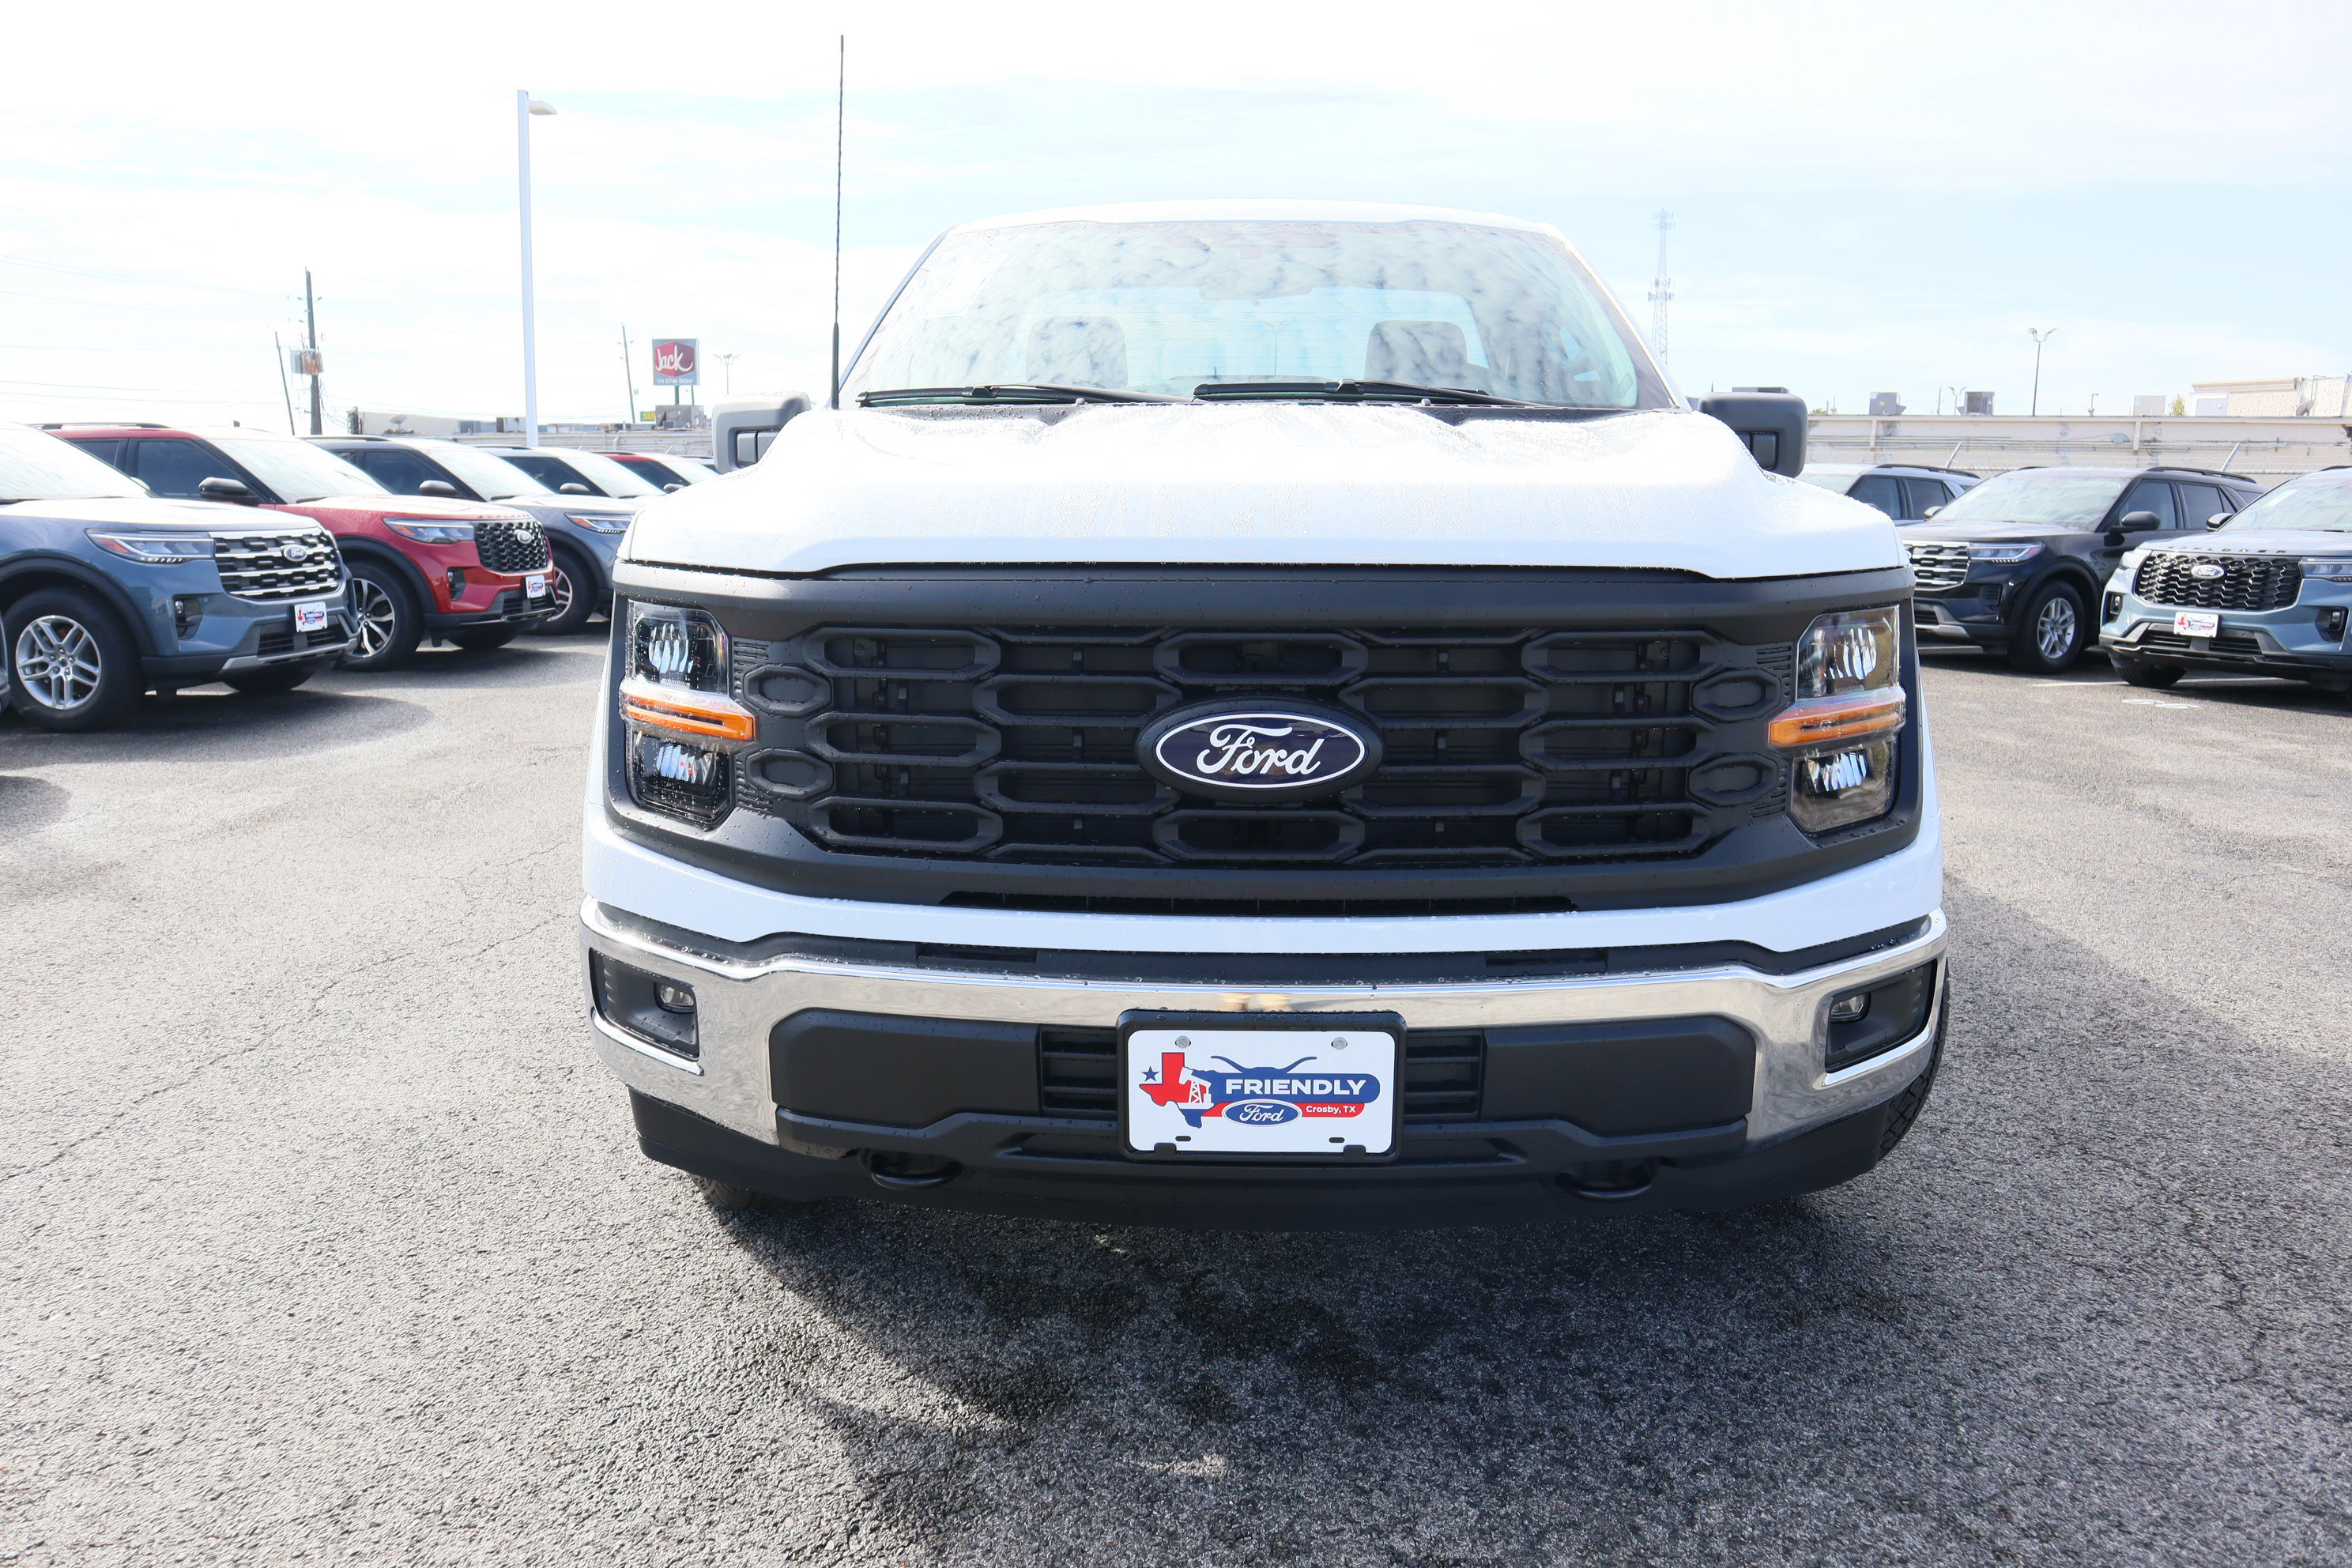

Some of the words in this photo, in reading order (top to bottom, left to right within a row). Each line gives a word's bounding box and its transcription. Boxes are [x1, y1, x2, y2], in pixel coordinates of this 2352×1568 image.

[655, 345, 693, 371] Jack
[1197, 723, 1325, 775] Ford
[1225, 1078, 1366, 1095] FRIENDLY
[1238, 1103, 1284, 1122] Ford
[1306, 1106, 1342, 1114] Crosby,
